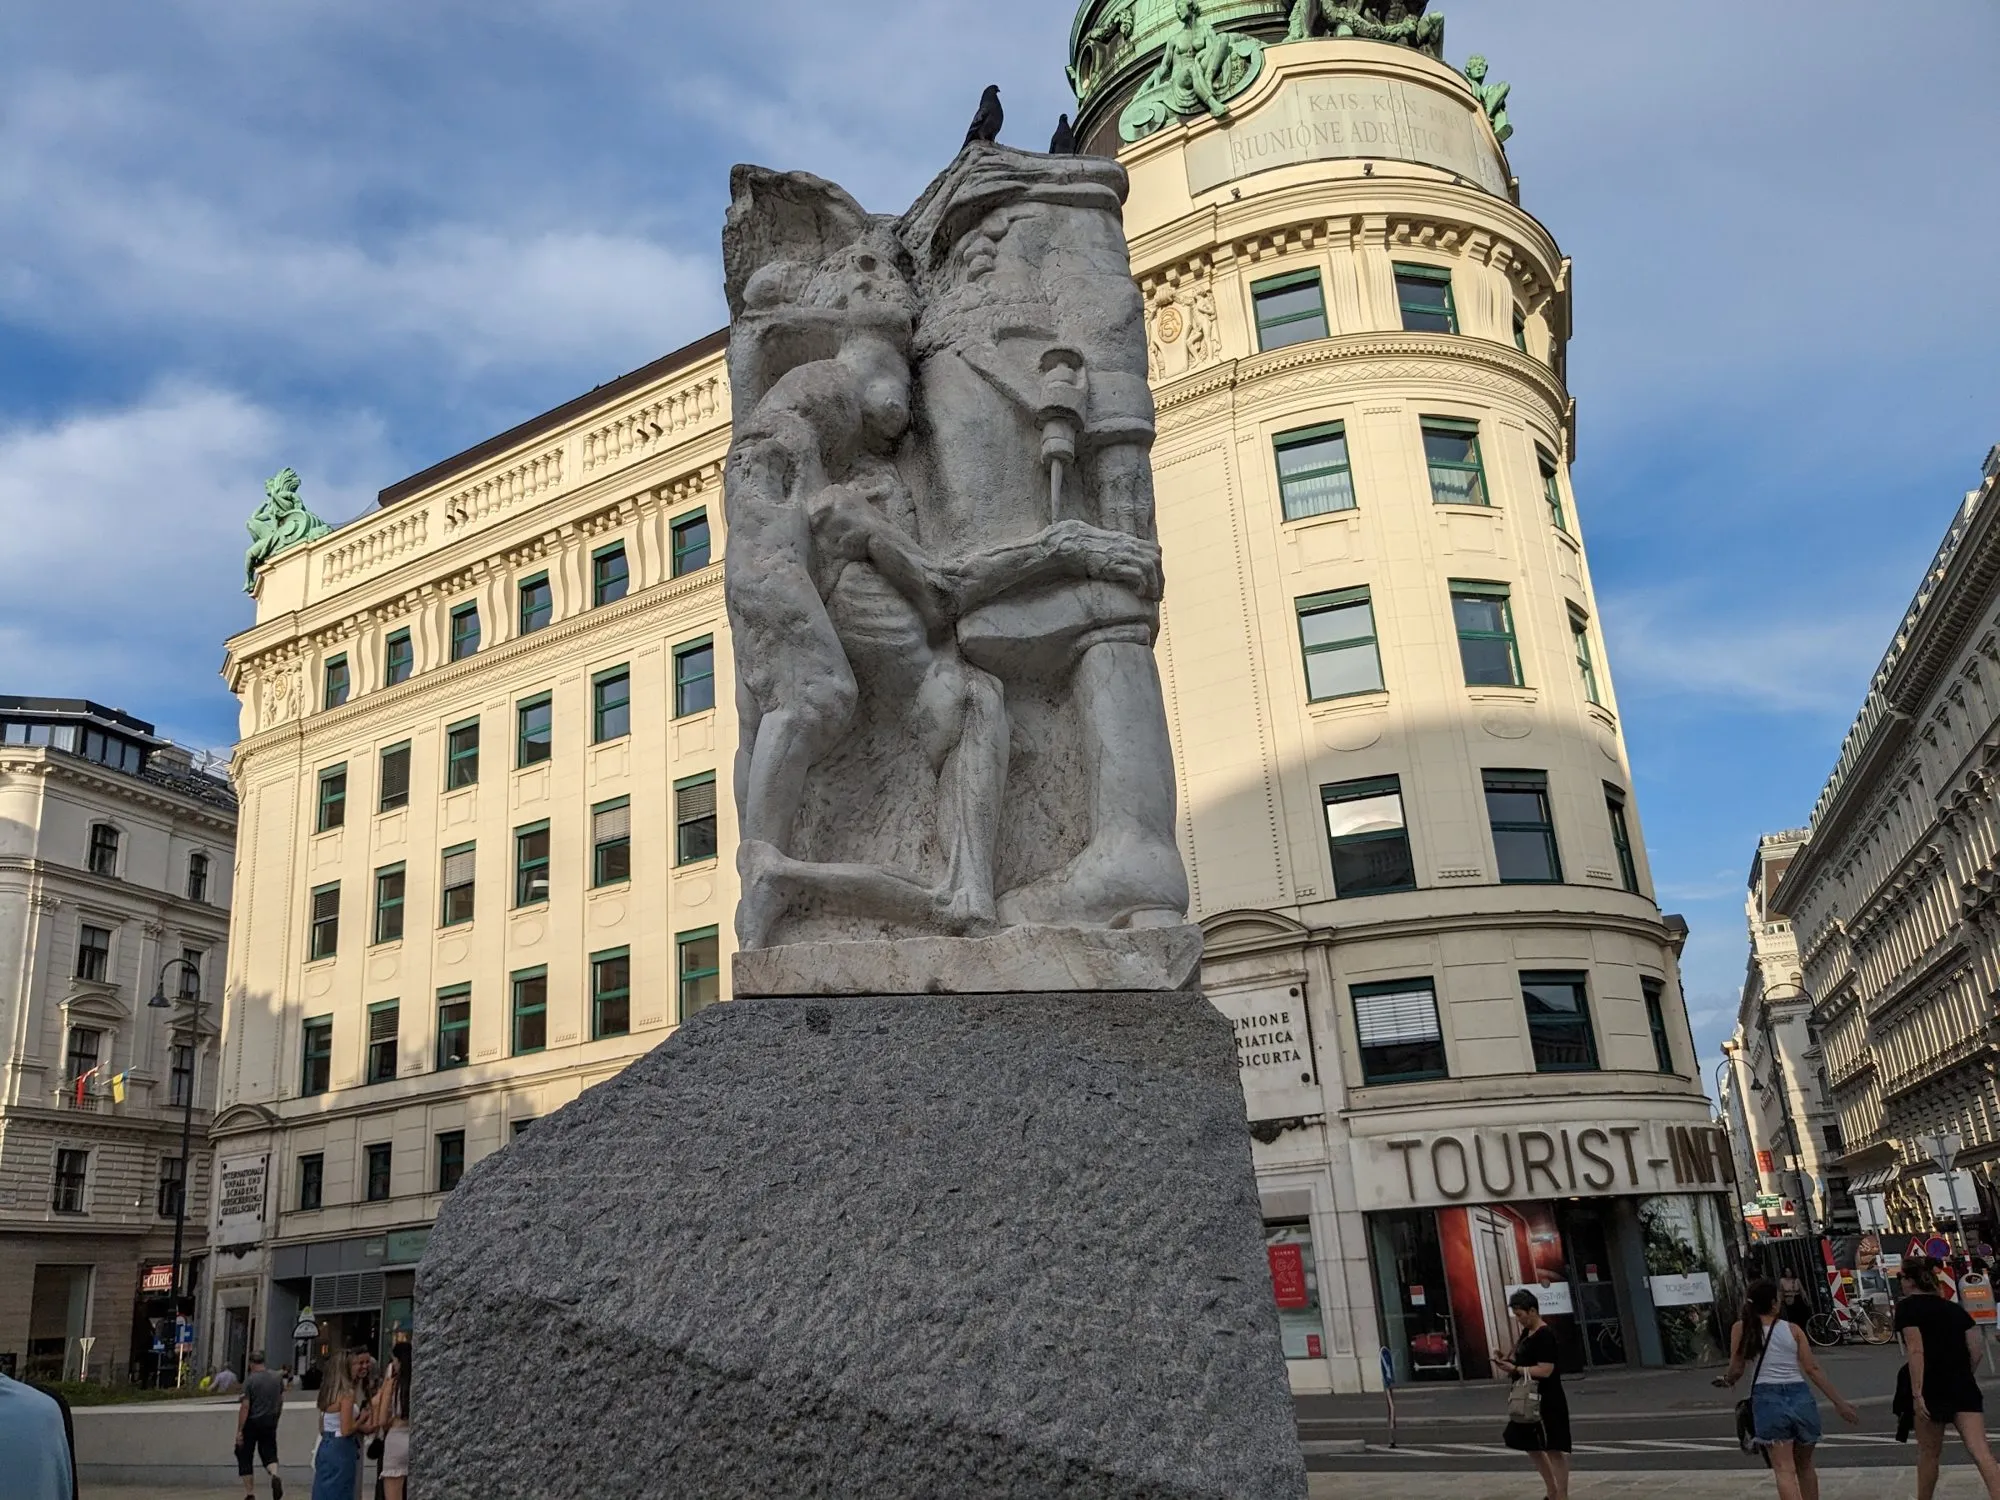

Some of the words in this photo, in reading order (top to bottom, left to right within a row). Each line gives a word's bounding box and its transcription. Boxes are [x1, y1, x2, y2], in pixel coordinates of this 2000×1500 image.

[1232, 121, 1343, 164] RIUNIONE
[1350, 121, 1452, 158] ADRIATICA
[1232, 1011, 1290, 1031] UNIONE
[1235, 1030, 1294, 1049] RIATICA
[1386, 1126, 1734, 1202] TOURIST-INF
